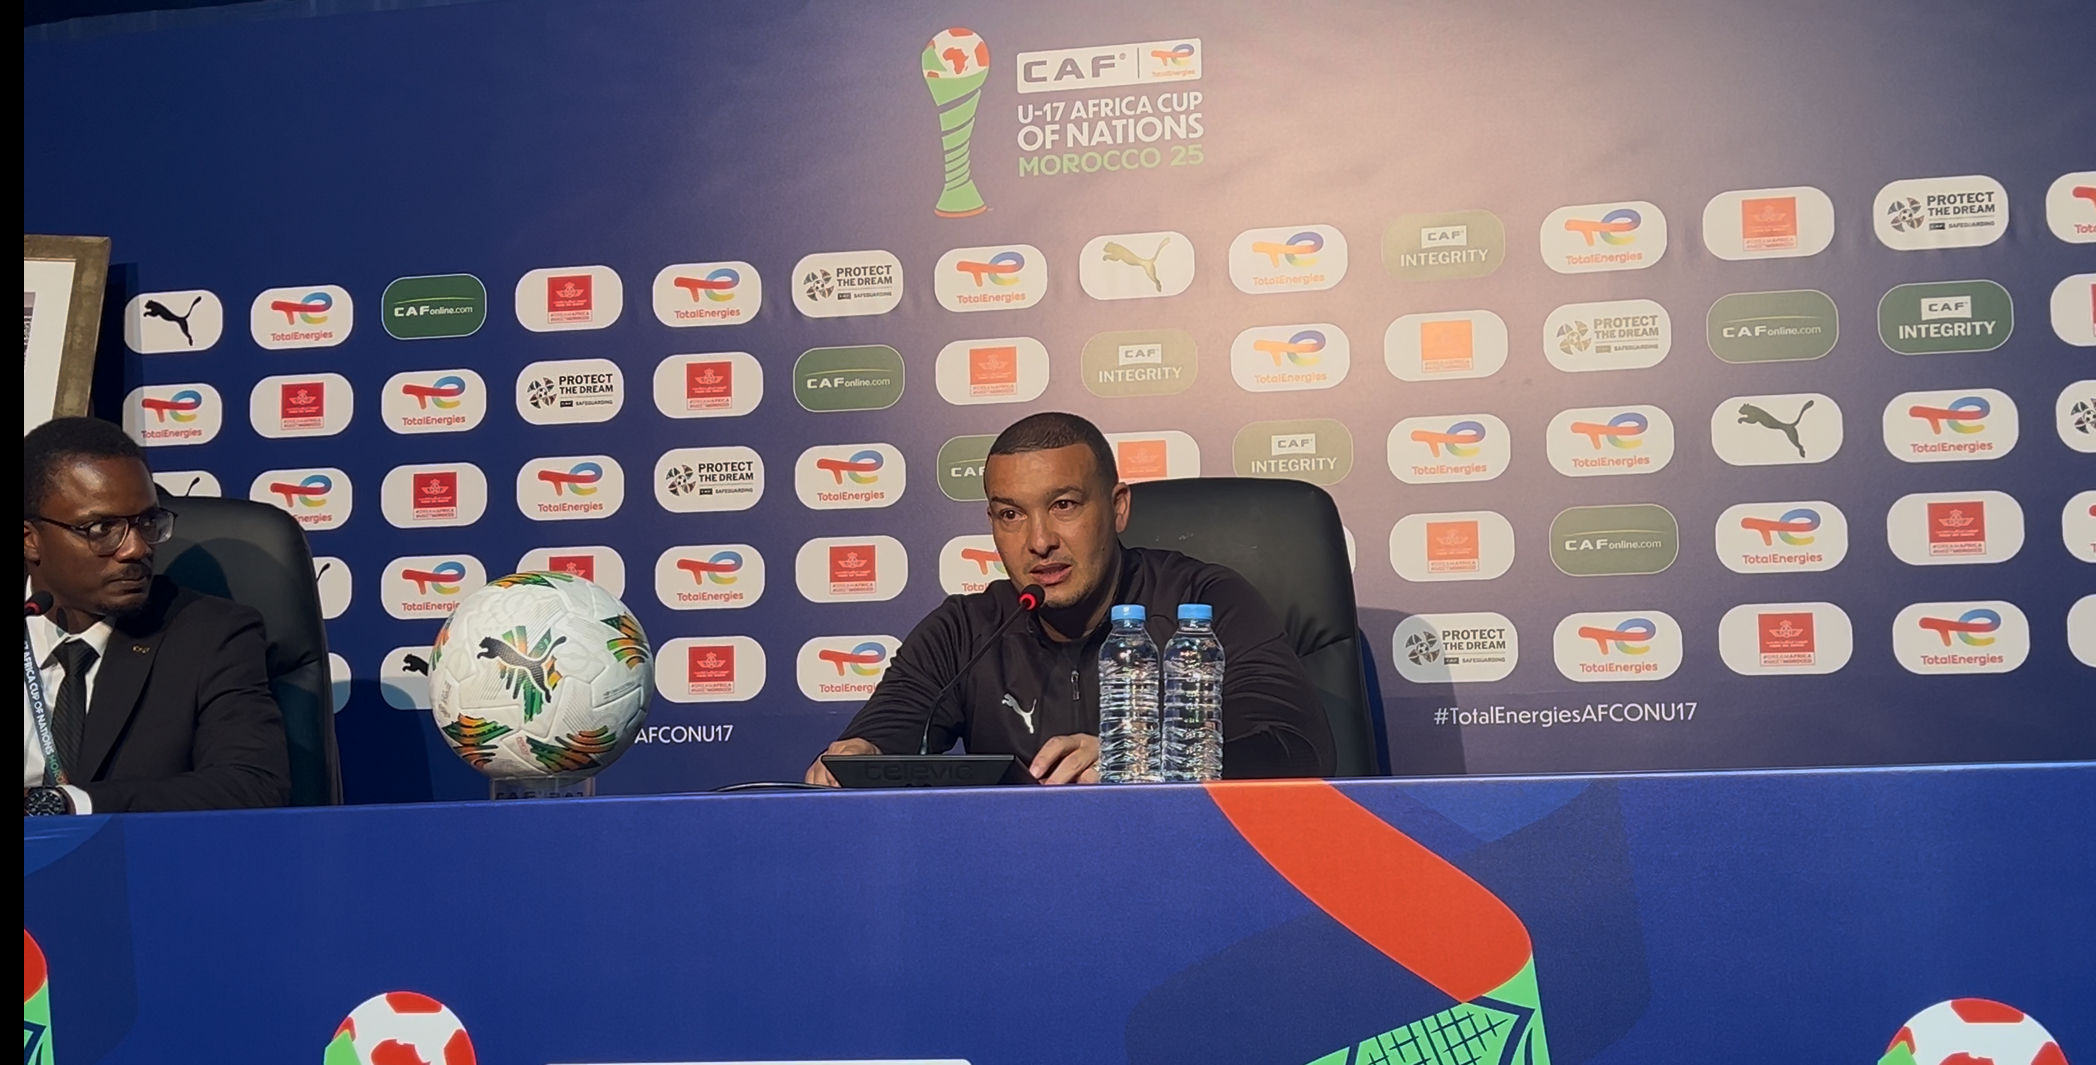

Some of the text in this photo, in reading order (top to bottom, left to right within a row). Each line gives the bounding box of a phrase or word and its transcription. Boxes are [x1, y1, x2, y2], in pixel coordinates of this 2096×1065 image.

[1017, 91, 1204, 124] U-17 AFRICA CUP
[1017, 113, 1204, 151] OF NATIONS
[1018, 144, 1204, 177] MOROCCO 25
[1926, 191, 1995, 206] PROTECT
[1927, 203, 1995, 216] THE DREAM
[1948, 221, 1995, 229] SAFEGUARDING
[1427, 230, 1461, 241] CAF
[1400, 249, 1489, 267] INTEGRITY
[1565, 251, 1643, 265] TotalEnergies
[836, 264, 892, 278] PROTECT
[837, 275, 893, 287] THE DREAM
[1252, 273, 1325, 286] TotalEnergies
[853, 291, 892, 299] SAFEGUARDING
[957, 292, 1026, 305] TotalEnergies
[394, 304, 473, 318] CAFonline.com
[674, 307, 741, 319] TotalEnergies
[1928, 302, 1966, 312] CAF
[1593, 315, 1659, 330] PROTECT
[270, 330, 333, 342] TotalEnergies
[1594, 327, 1659, 340] THE DREAM
[1722, 325, 1822, 338] CAFonline.com
[1898, 320, 1996, 339] INTEGRITY
[1124, 348, 1158, 358] CAF
[558, 373, 613, 386] PROTECT
[1099, 366, 1183, 383] INTEGRITY
[1254, 371, 1328, 385] TotalEnergies
[559, 384, 614, 395] THE DREAM
[806, 376, 891, 390] CAFonline.com
[402, 413, 466, 426] TotalEnergies
[141, 428, 203, 440] TotalEnergies
[1277, 438, 1310, 449] CAF
[1910, 441, 1994, 454] TotalEnergies
[698, 461, 753, 473] PROTECT
[1251, 457, 1337, 473] INTEGRITY
[1572, 455, 1650, 469] TotalEnergies
[1411, 462, 1488, 476] TotalEnergies
[699, 472, 754, 483] THE DREAM
[817, 490, 885, 502] TotalEnergies
[537, 501, 603, 513] TotalEnergies
[292, 513, 333, 525] Energies
[1564, 539, 1662, 551] CAFonline.com
[1742, 552, 1824, 566] TotalEnergies
[677, 591, 744, 603] TotalEnergies
[1442, 628, 1505, 641] PROTECT
[1442, 640, 1506, 651] THE DREAM
[1462, 656, 1506, 664] SAFEGUARDING
[1920, 653, 2004, 667] TotalEnergies
[1579, 661, 1658, 675] TotalEnergies
[29, 682, 40, 700] CUP
[819, 682, 877, 694] TotalEnergi
[34, 701, 44, 715] OF
[1433, 702, 1698, 728] #TotalEnergiesAFCONU17
[37, 714, 55, 756] NATIONS
[864, 763, 974, 781] televic
